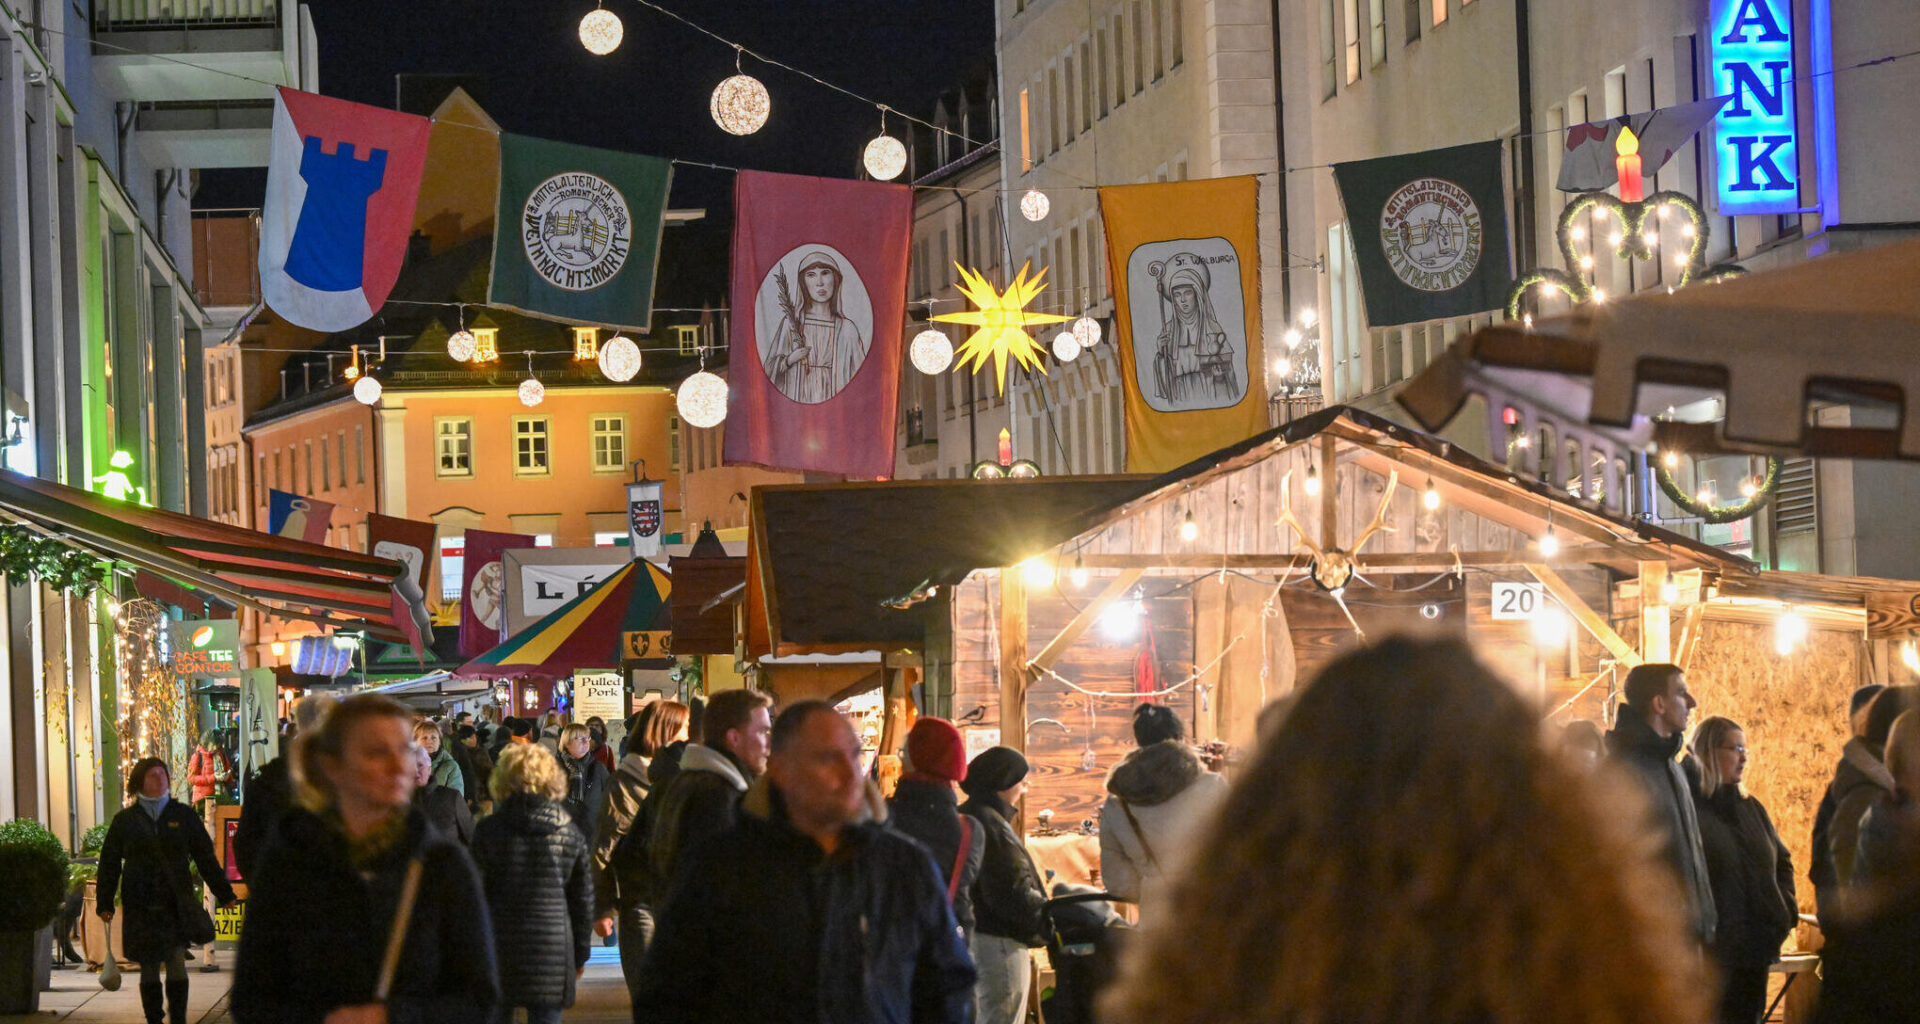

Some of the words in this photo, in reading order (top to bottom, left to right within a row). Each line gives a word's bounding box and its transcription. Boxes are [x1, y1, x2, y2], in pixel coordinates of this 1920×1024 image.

[525, 214, 629, 288] WEIHNACHTSMARKT
[1500, 589, 1534, 613] 20
[208, 650, 233, 661] TEE
[175, 662, 232, 674] CONTOR
[581, 677, 621, 687] Pulled
[587, 688, 618, 698] Pork
